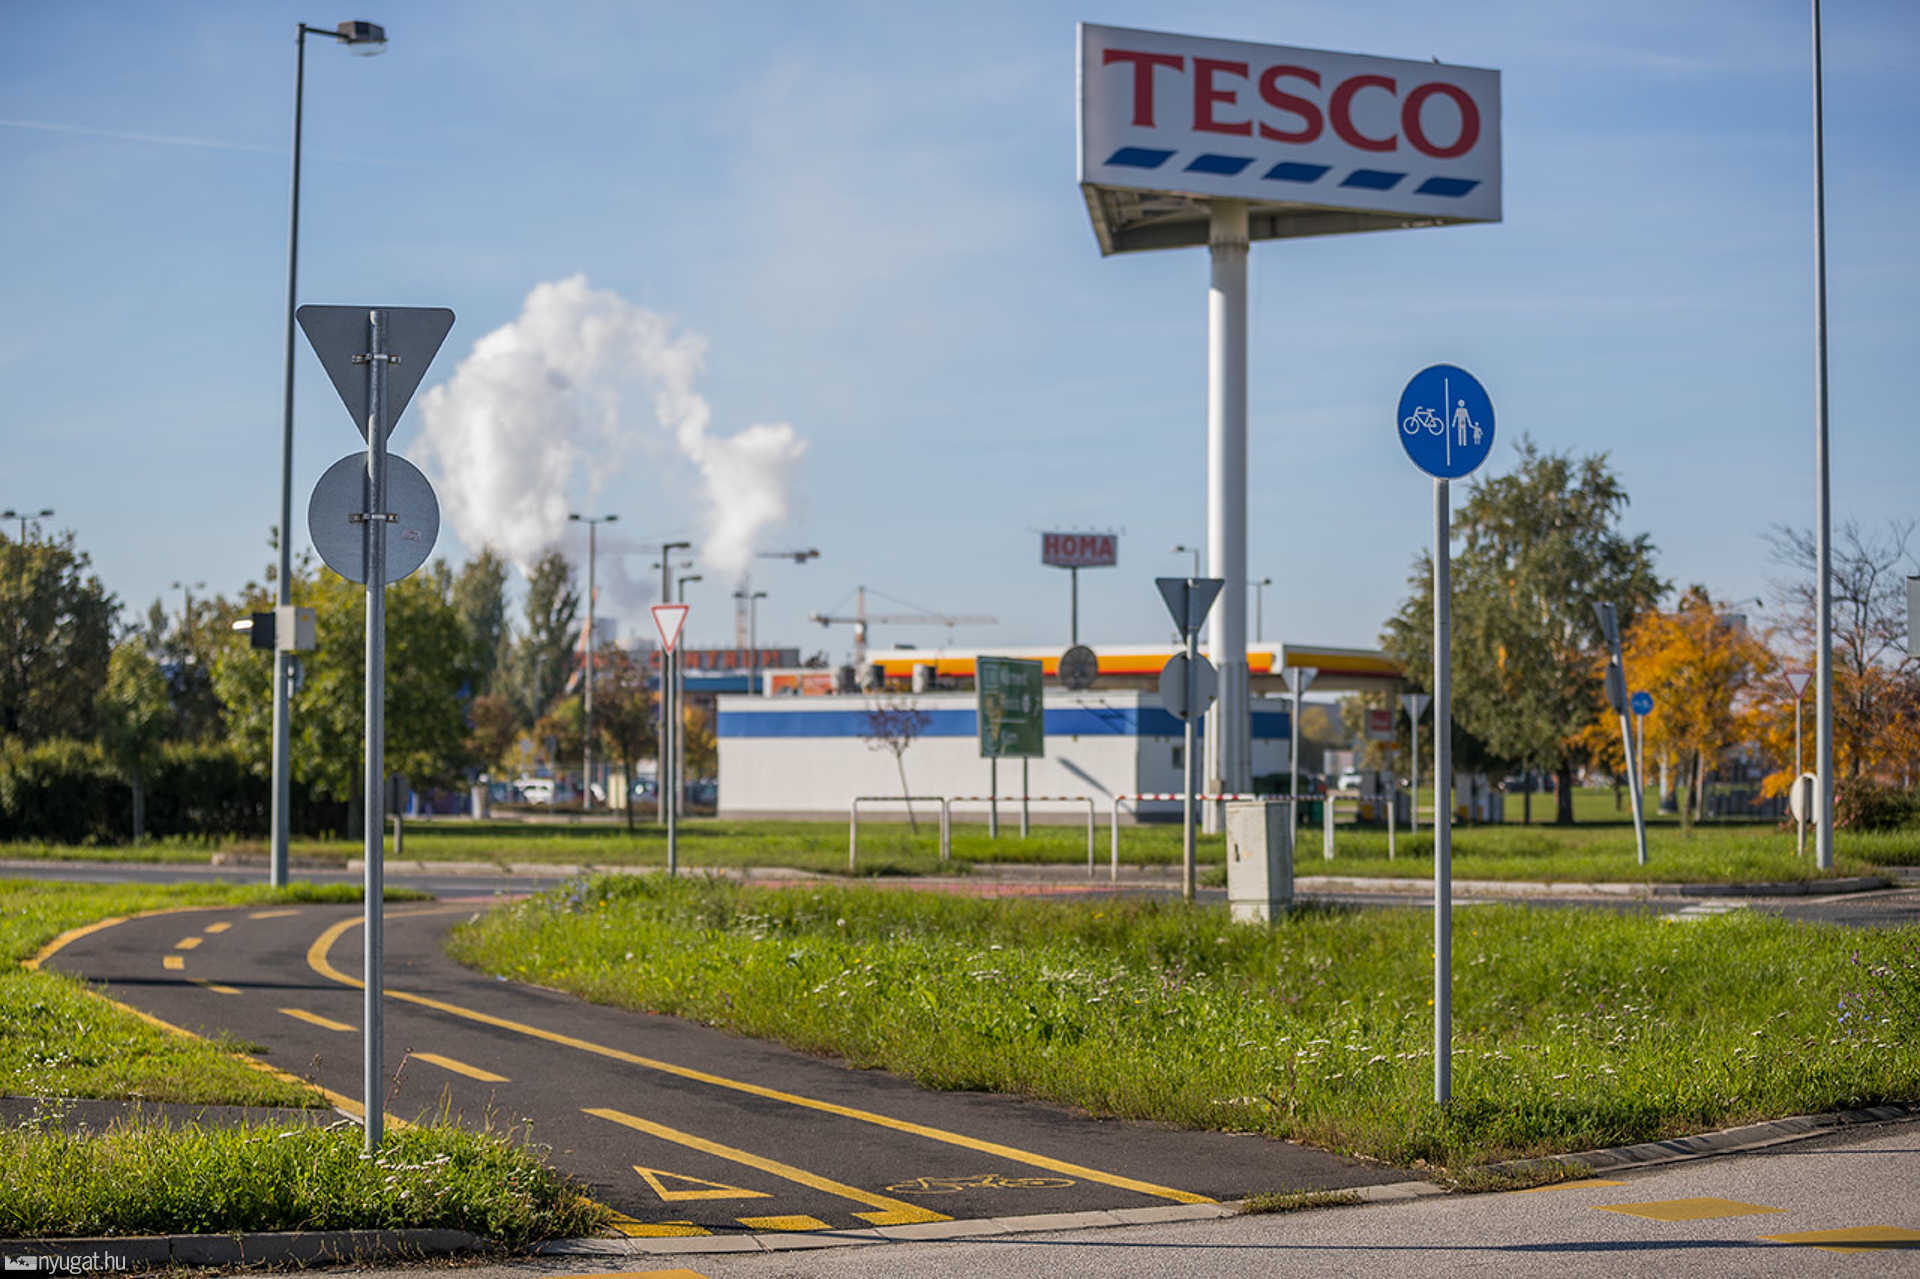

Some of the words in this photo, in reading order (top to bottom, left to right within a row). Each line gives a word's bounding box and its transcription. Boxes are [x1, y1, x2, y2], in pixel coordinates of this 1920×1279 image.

[1103, 48, 1481, 158] TESCO
[1045, 534, 1114, 557] HOMA
[649, 650, 780, 668] CNTRUM
